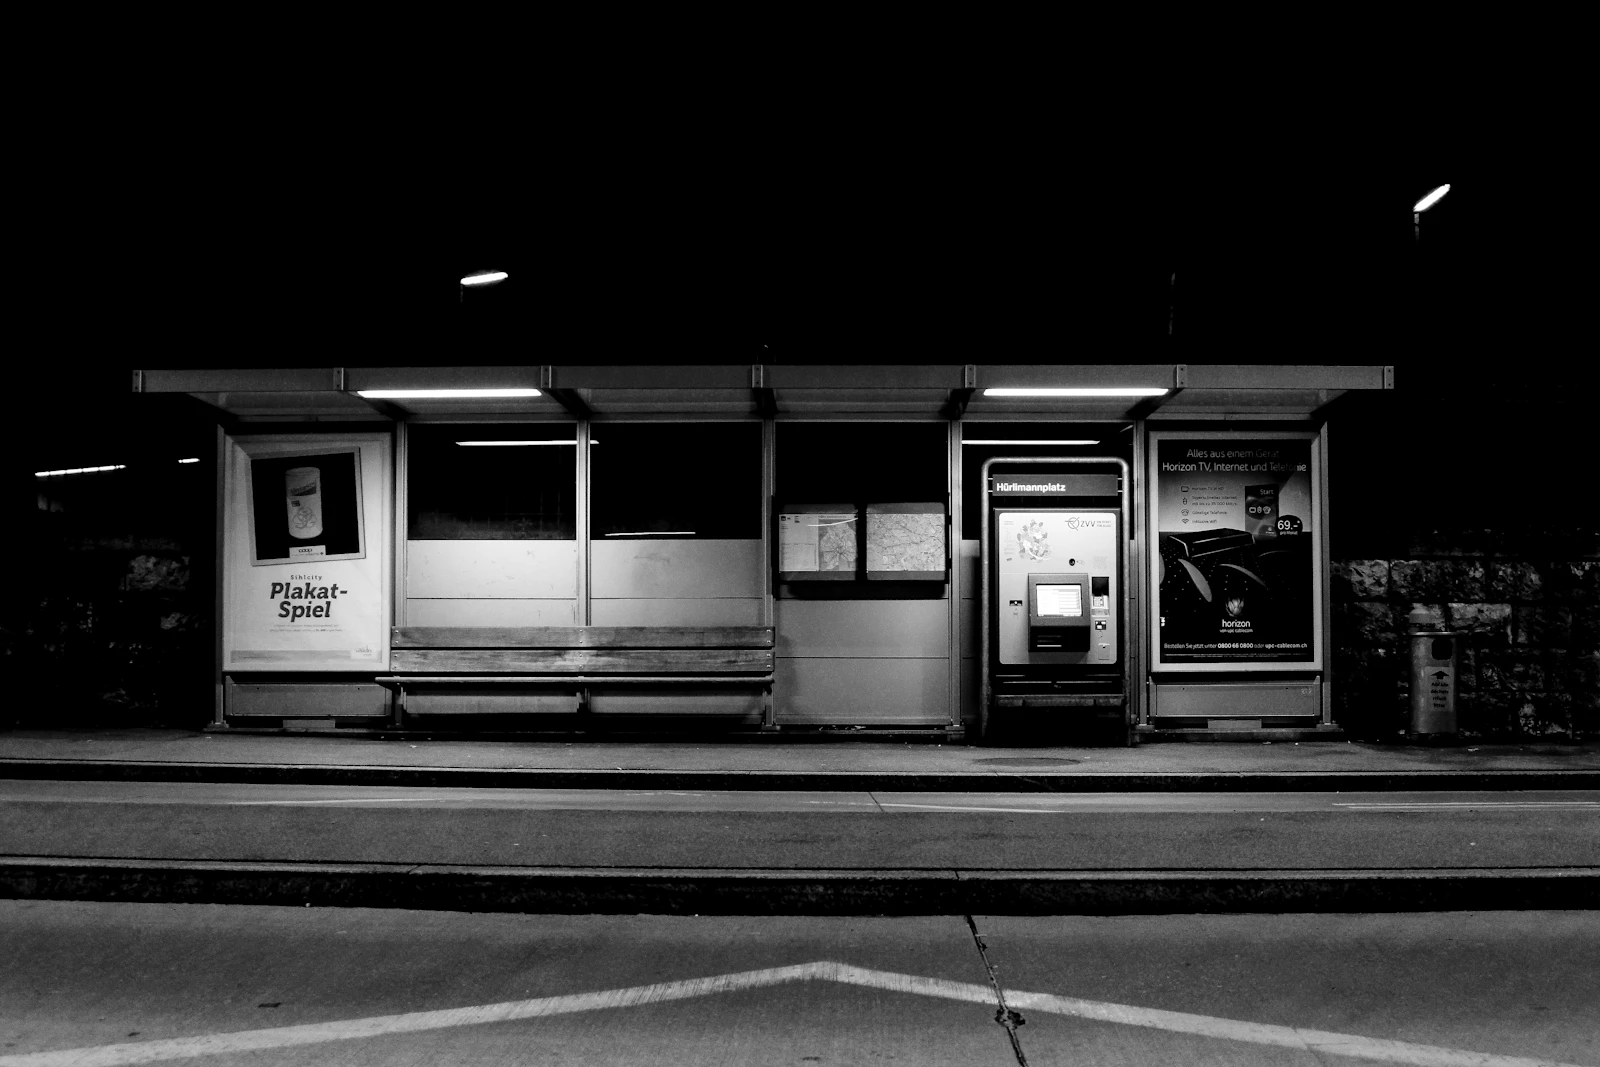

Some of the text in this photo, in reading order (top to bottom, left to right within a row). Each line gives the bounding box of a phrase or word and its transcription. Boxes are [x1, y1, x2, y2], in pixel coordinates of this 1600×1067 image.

[1187, 448, 1208, 458] Alles
[1210, 450, 1225, 458] aus
[1227, 449, 1253, 458] einem
[1162, 462, 1197, 471] Horizon
[1198, 461, 1212, 473] TV,
[1213, 461, 1248, 471] Internet
[1250, 461, 1267, 471] und
[996, 482, 1066, 493] Hürlimannplatz
[269, 582, 348, 600] Plakat-
[278, 600, 331, 623] Spiel
[1221, 618, 1251, 628] horizon
